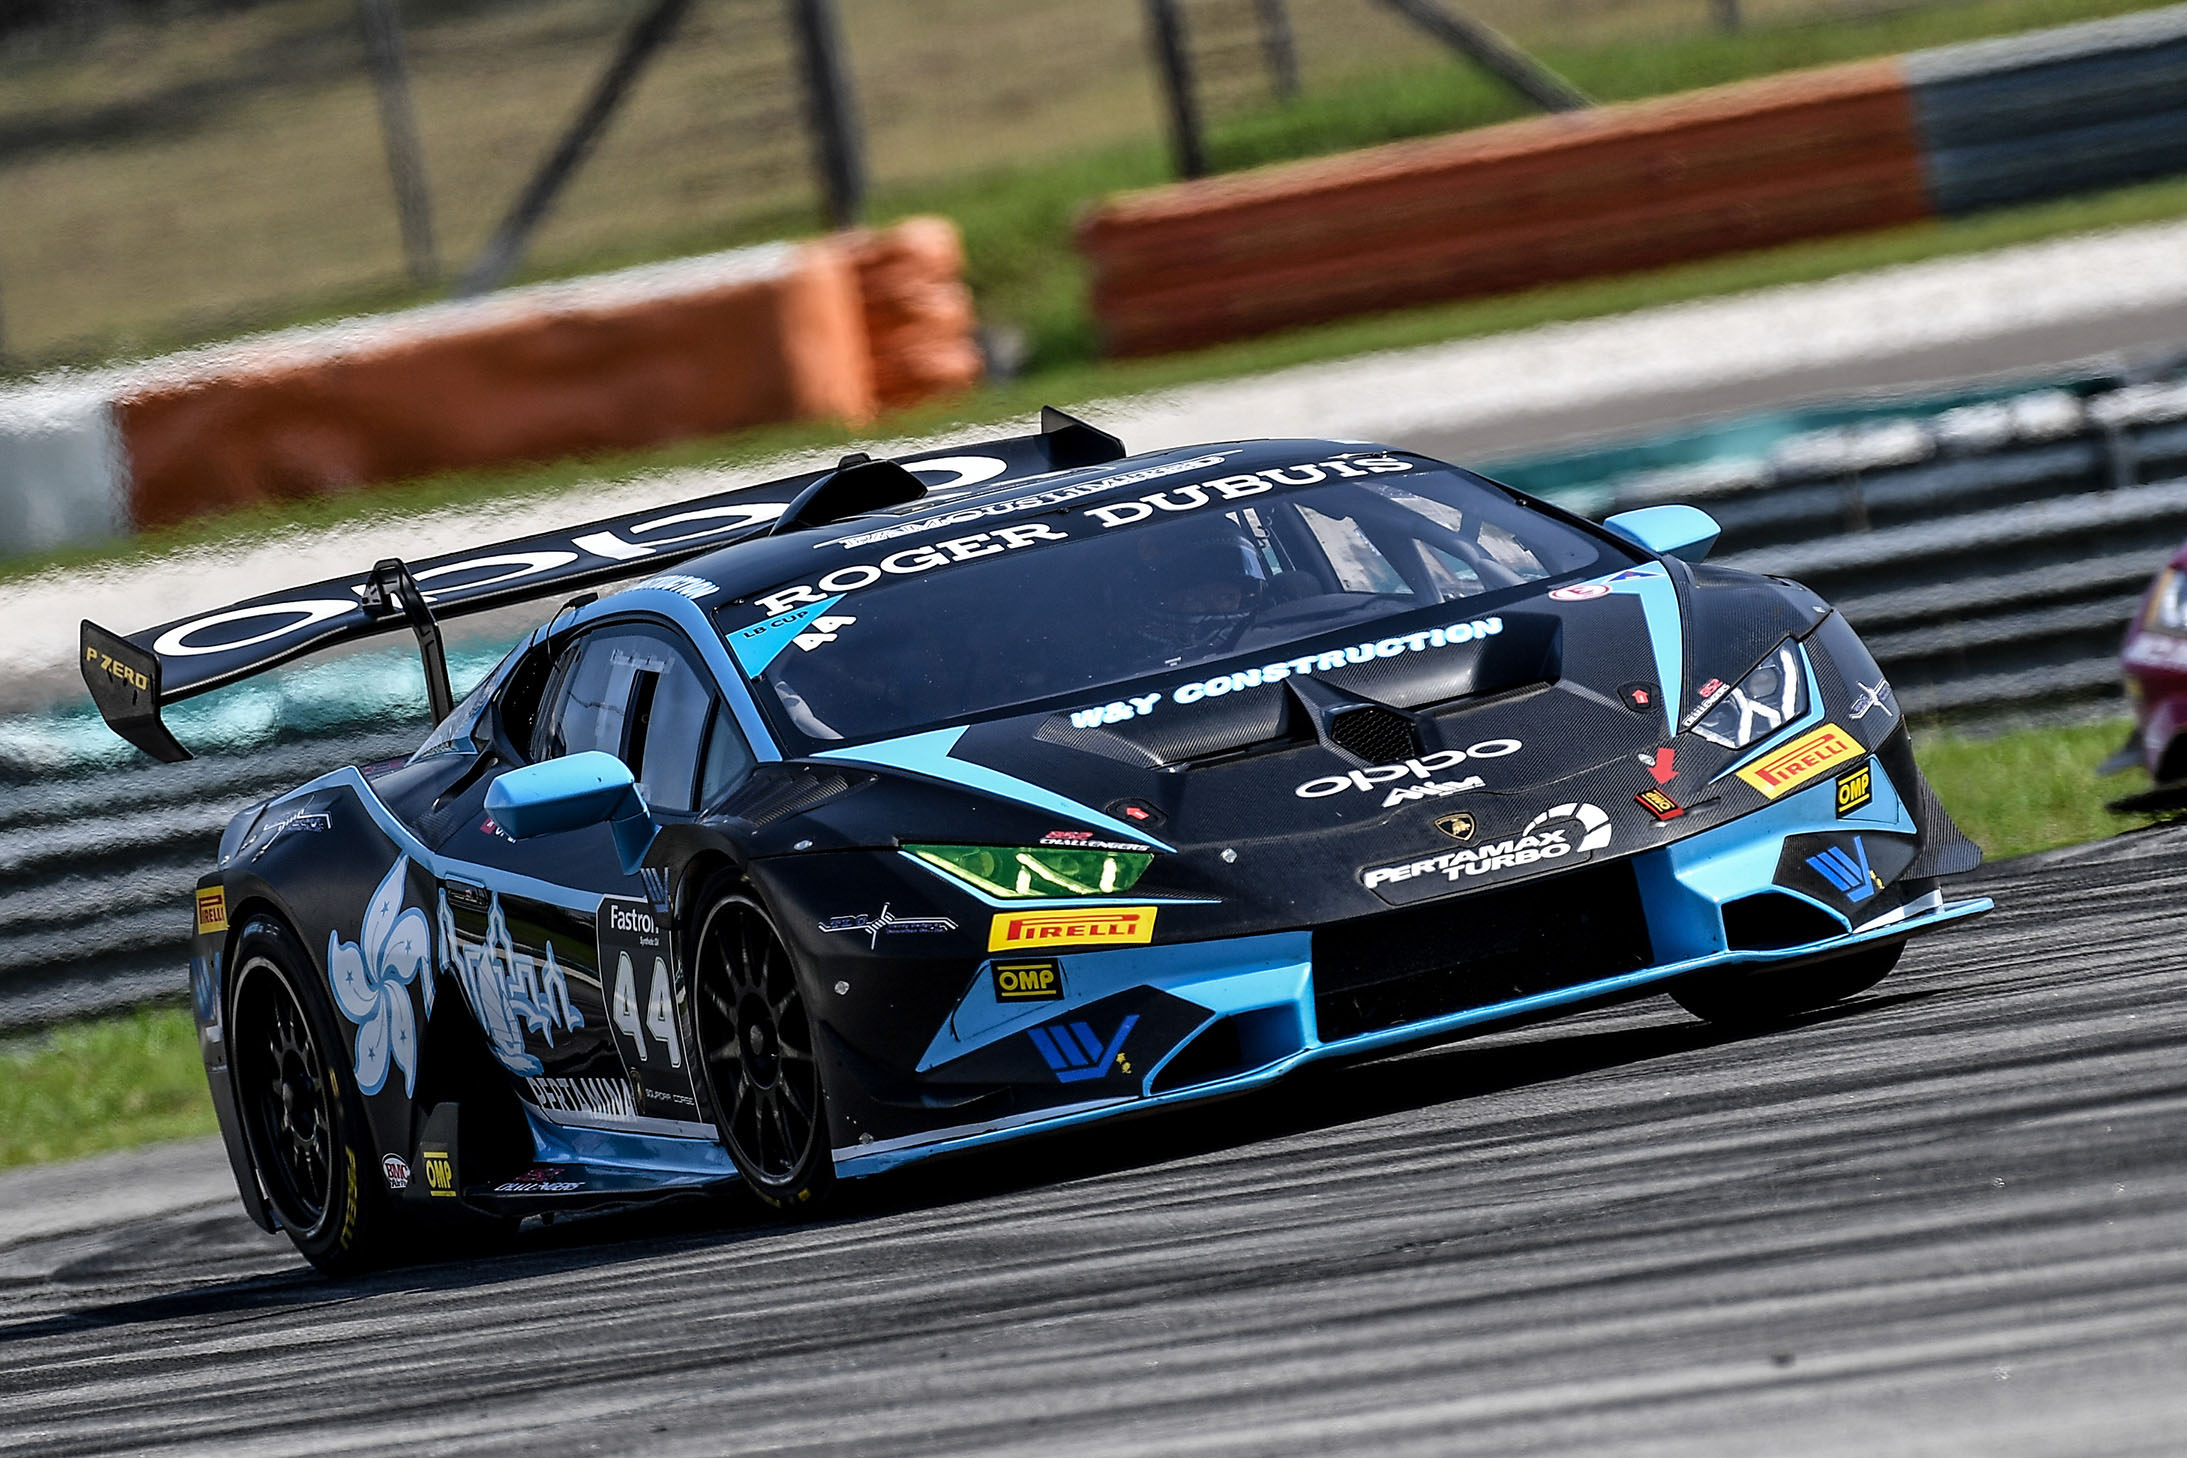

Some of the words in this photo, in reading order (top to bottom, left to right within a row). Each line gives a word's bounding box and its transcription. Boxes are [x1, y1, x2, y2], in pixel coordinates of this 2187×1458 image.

[754, 523, 1069, 617] ROGER
[1084, 457, 1414, 528] DUBUIS
[743, 626, 767, 638] LB
[770, 610, 809, 627] CUP
[86, 646, 99, 662] P
[101, 653, 149, 690] ZERO
[1070, 692, 1162, 729] W&Y
[1173, 616, 1504, 704] CONSTRUCTION
[1295, 738, 1523, 798] oppo
[1754, 733, 1849, 788] PIRELLI
[1645, 791, 1673, 811] OMP
[1838, 773, 1870, 805] OMP
[1039, 838, 1151, 852] CHALLENGERS
[1363, 829, 1567, 889] PERTAMAX
[1442, 843, 1572, 882] TURBO
[1006, 914, 1141, 942] PIRELLI
[999, 969, 1055, 991] OMP
[612, 950, 682, 1069] 44
[525, 1077, 639, 1119] PERTAMINA
[385, 1163, 409, 1180] BMC
[425, 1159, 453, 1189] OMP
